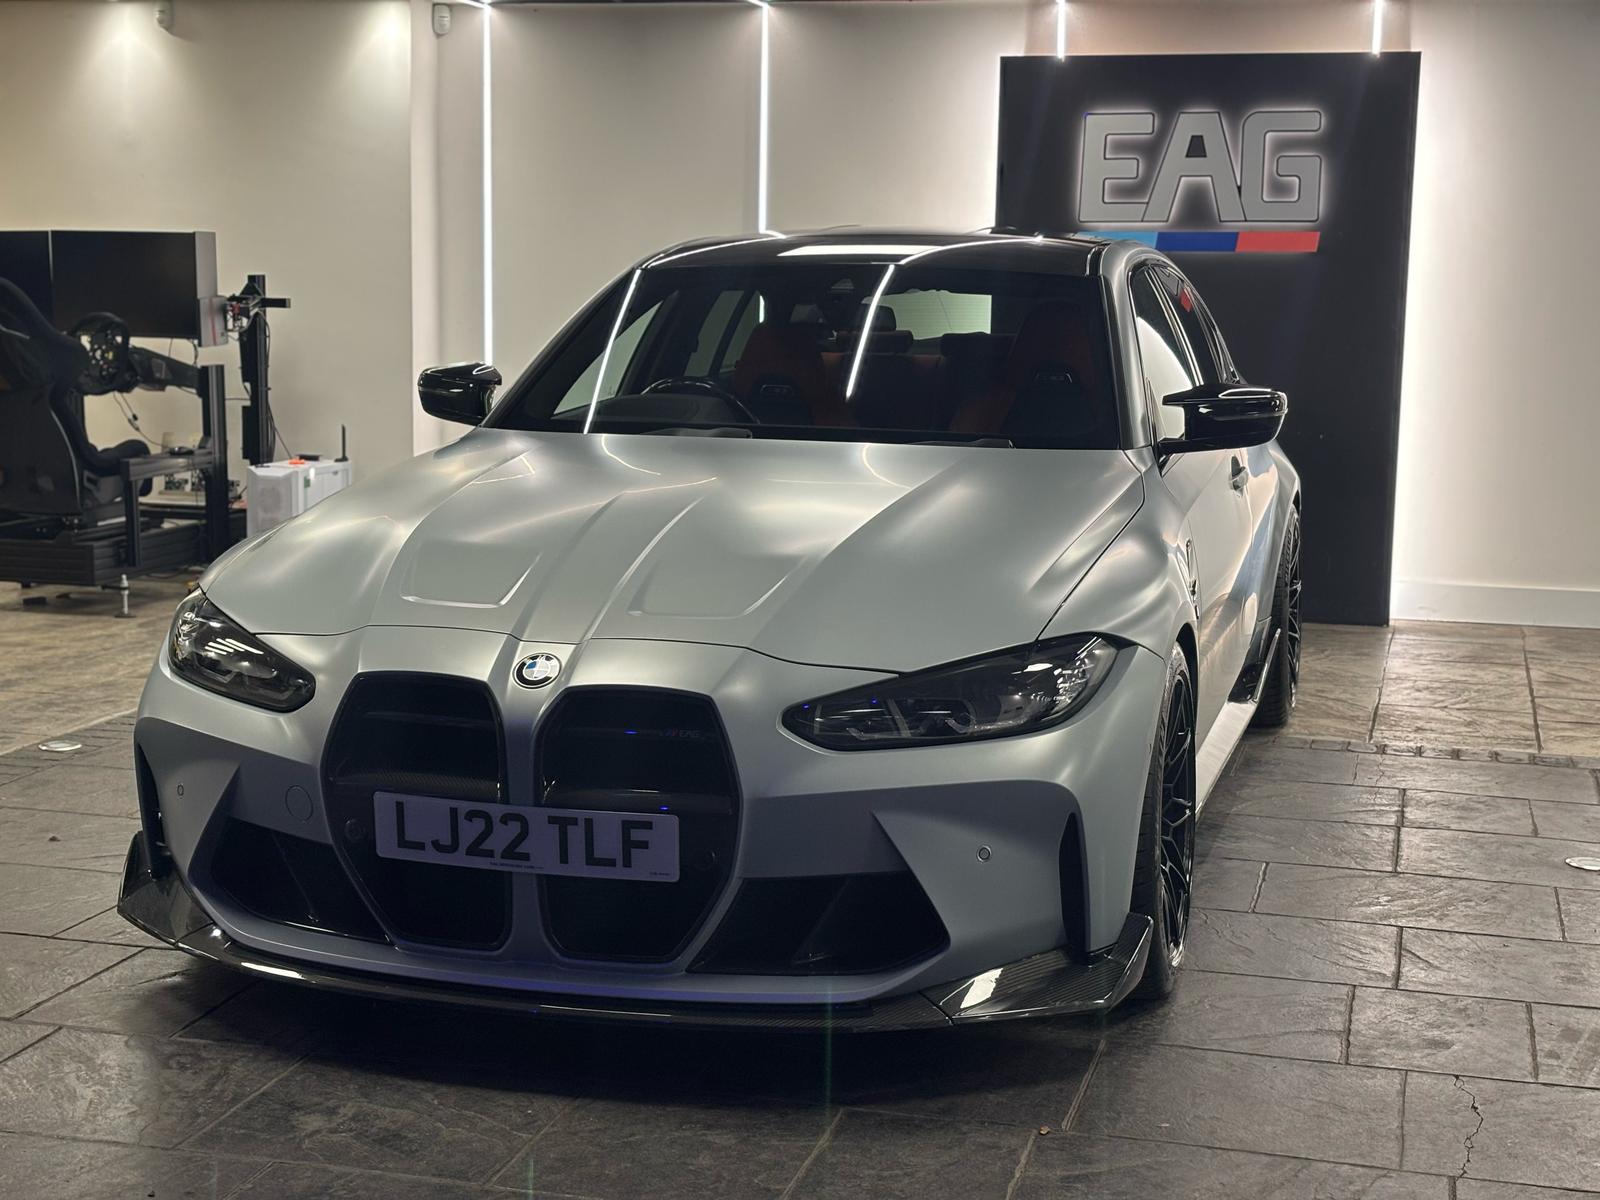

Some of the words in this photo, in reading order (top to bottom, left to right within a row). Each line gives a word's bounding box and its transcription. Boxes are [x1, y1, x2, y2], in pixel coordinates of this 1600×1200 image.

[1079, 111, 1322, 223] EAG
[395, 801, 530, 862] LJ22
[547, 815, 653, 868] TLF
